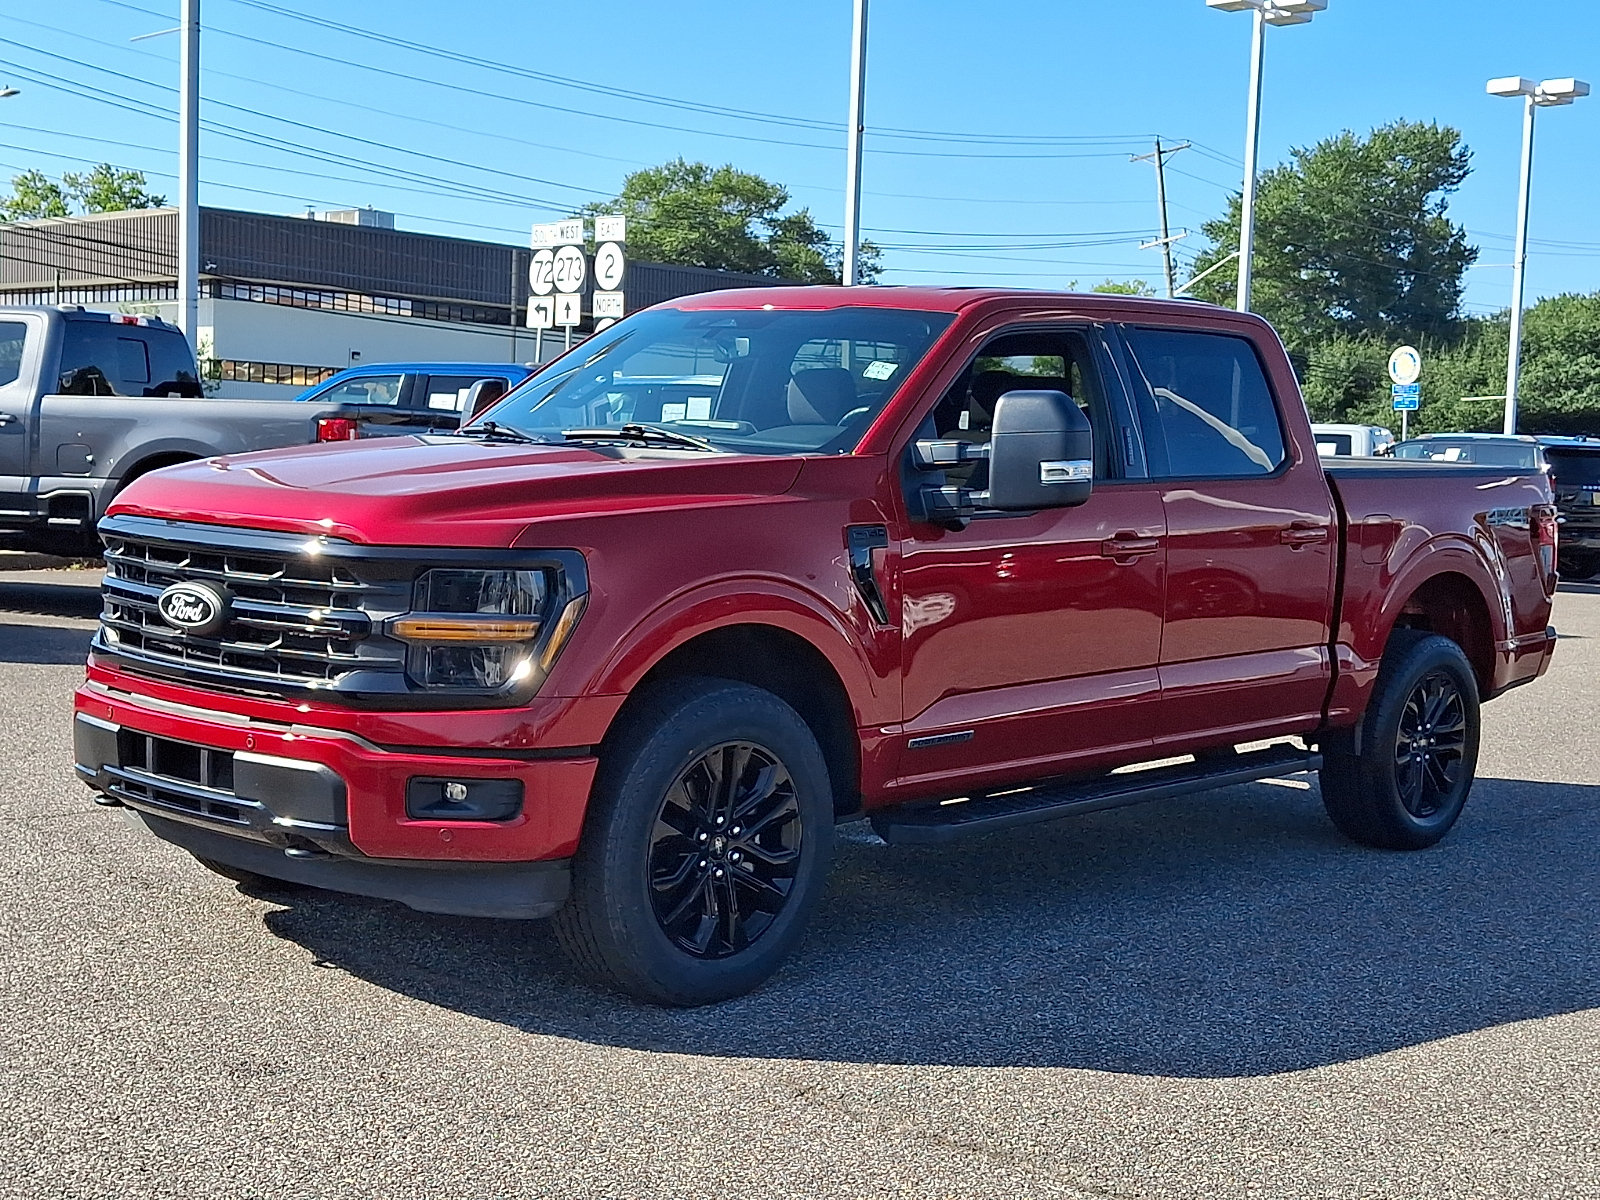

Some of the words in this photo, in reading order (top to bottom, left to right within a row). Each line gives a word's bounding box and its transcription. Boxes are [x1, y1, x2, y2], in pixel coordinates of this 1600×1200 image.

[560, 226, 579, 239] WEST
[601, 222, 620, 236] EAST
[535, 260, 553, 284] 72
[557, 256, 582, 282] 273
[605, 253, 614, 279] 2
[596, 298, 622, 312] NORTH
[167, 592, 204, 621] Ford
